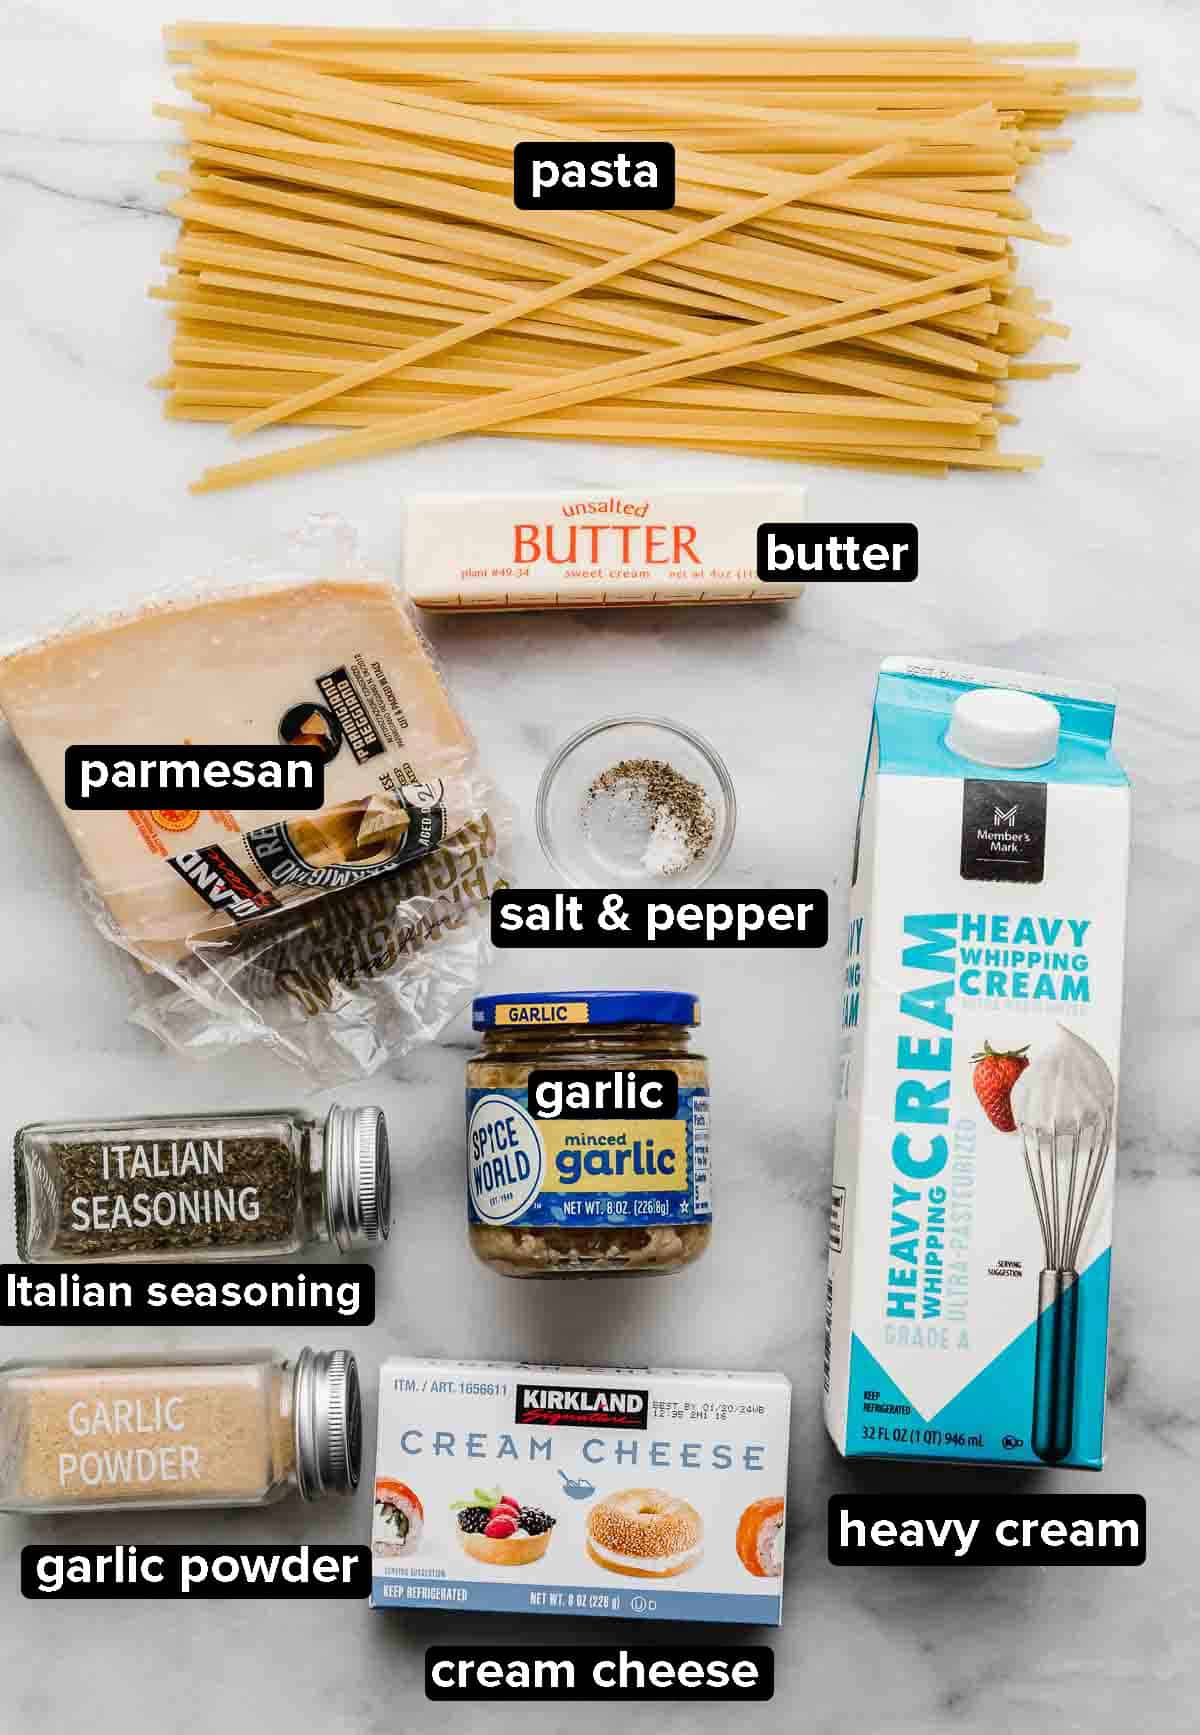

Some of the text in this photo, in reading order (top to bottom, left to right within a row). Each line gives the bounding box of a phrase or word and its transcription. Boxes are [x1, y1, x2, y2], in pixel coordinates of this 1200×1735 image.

[561, 497, 648, 519] unsalted
[513, 524, 702, 564] BUTTER
[461, 568, 487, 580] plant
[564, 567, 650, 579] sweet cream
[319, 676, 369, 759] PARMIGIANO
[335, 678, 378, 745] REGGIANO
[418, 816, 433, 847] AGED
[977, 829, 1032, 842] Member's
[990, 841, 1018, 852] Mark
[961, 913, 1091, 947] HEAVY
[960, 947, 1089, 972] WHIPPING
[959, 969, 1091, 1002] CREAM
[508, 1007, 568, 1022] GARLIC
[891, 913, 958, 1180] CREAM
[473, 1116, 519, 1161] SPICE
[565, 1132, 627, 1146] minced
[102, 1141, 224, 1180] ITALIAN
[474, 1150, 530, 1196] WORLD
[555, 1139, 676, 1185] garlic
[71, 1187, 260, 1232] SEASONING
[563, 1201, 582, 1215] NET
[585, 1201, 604, 1215] WT.
[607, 1201, 614, 1215] 8
[945, 1119, 976, 1321] ULTRA-PASTEURIZED
[886, 1183, 921, 1320] HEAVY
[922, 1185, 947, 1320] WHIPPING
[884, 1323, 970, 1349] GRADE A
[393, 1379, 418, 1393] ITM.
[431, 1382, 457, 1394] ART.
[460, 1383, 507, 1397] 1656611
[523, 1389, 643, 1413] KIRKLAND
[864, 1391, 880, 1401] KEEP
[68, 1396, 185, 1437] GARLIC
[521, 1408, 641, 1426] Signature
[864, 1403, 911, 1415] REFRIGERATED
[400, 1430, 766, 1471] CREAM CHEESE
[863, 1426, 984, 1448] 32 FL OZ (1 QT) 946 mL
[59, 1448, 201, 1487] POWDER
[383, 1585, 467, 1601] KEEP REFRIGERATED
[530, 1592, 546, 1605] NET
[550, 1593, 565, 1606] WT.
[576, 1594, 588, 1607] OZ
